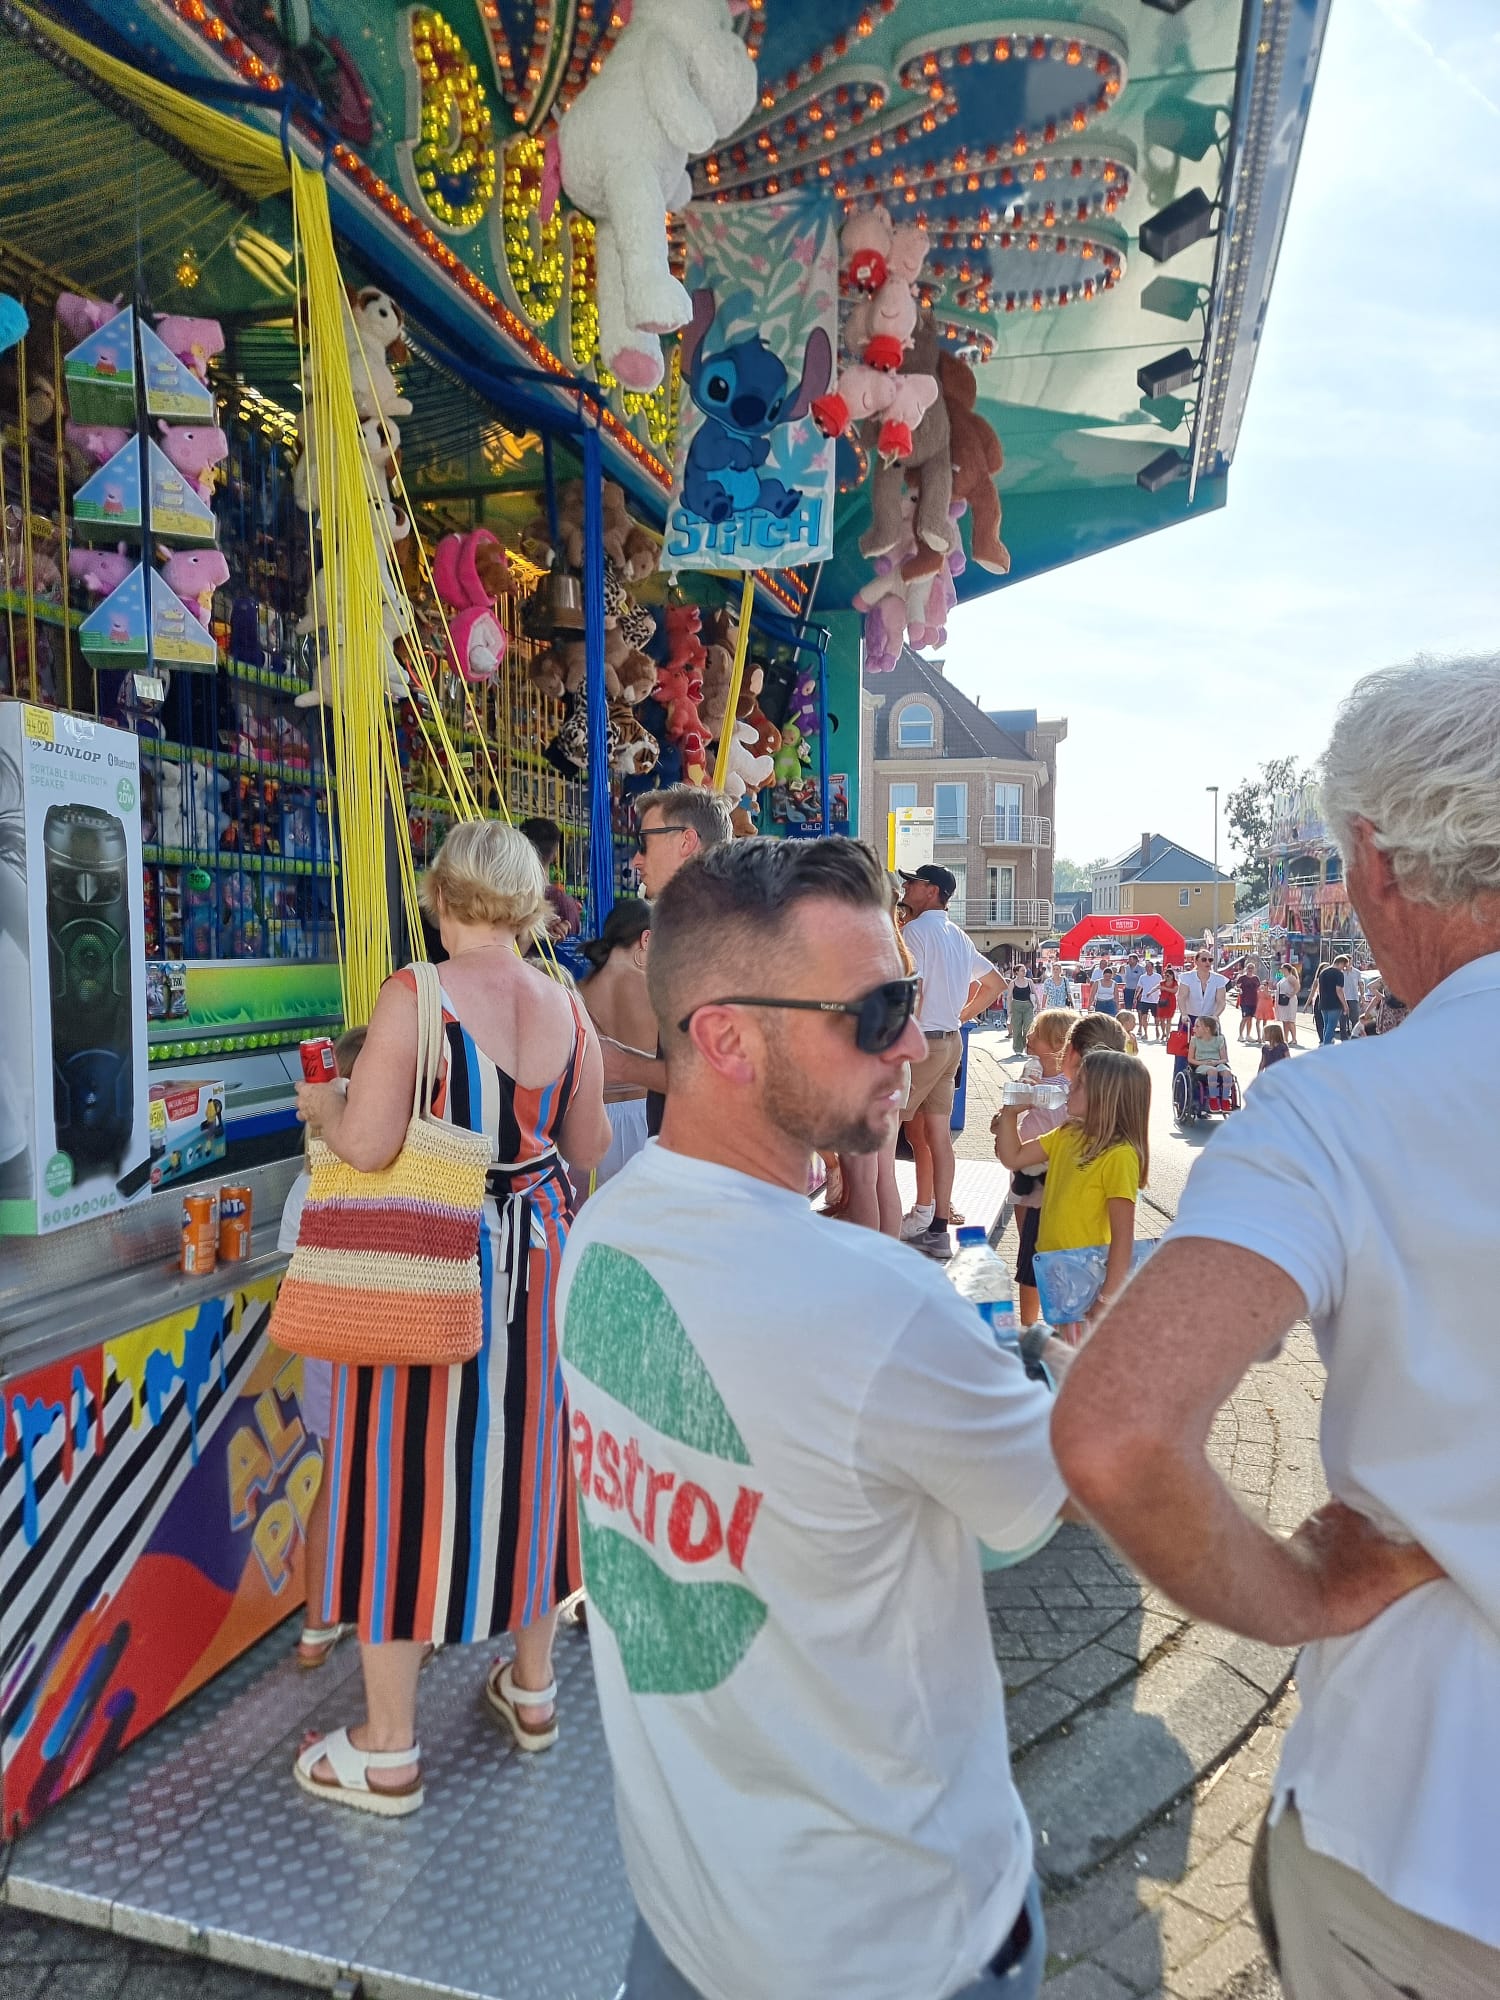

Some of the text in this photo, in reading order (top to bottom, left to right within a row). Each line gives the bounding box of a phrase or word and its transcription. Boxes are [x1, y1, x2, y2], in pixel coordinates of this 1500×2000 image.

[43, 741, 137, 771] DUNLOP Bluetooth
[31, 763, 108, 786] PORTABLE BLUETOOTH
[31, 775, 65, 791] SPEAKER
[118, 791, 135, 804] 20W
[222, 1199, 246, 1214] NTA
[572, 1408, 764, 1573] astrol
